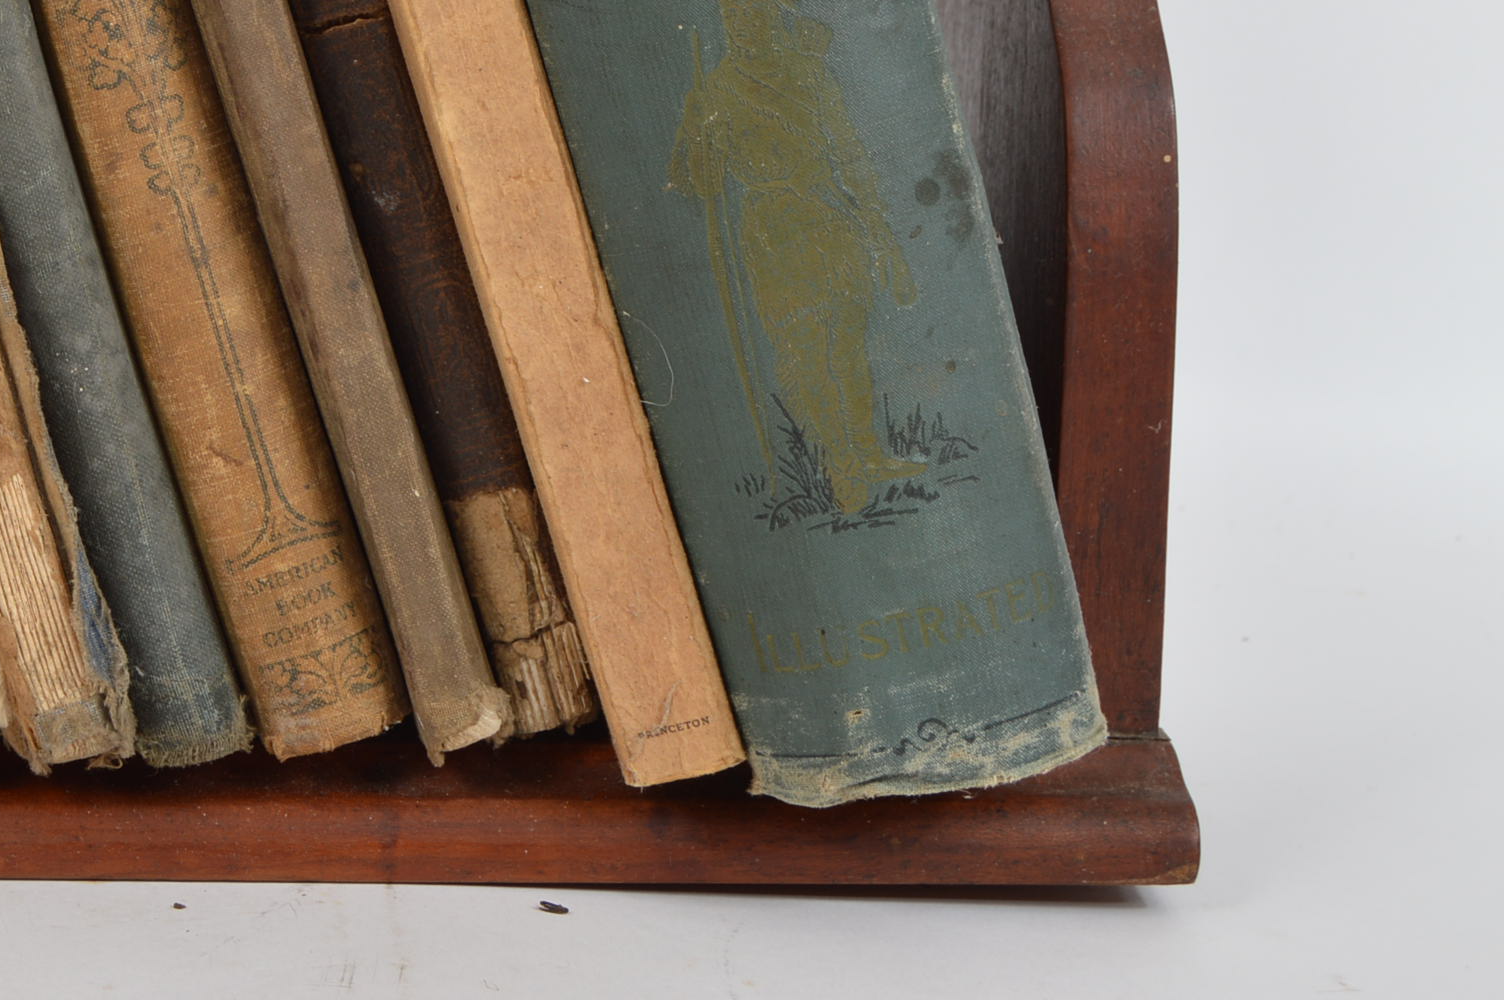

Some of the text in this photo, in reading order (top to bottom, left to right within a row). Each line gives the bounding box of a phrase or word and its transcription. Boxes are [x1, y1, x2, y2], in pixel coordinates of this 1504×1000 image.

[245, 546, 345, 596] AMERICAN
[275, 583, 337, 617] BOOK
[263, 606, 356, 649] COMPANY
[746, 573, 1057, 672] ILLUSTRATED
[638, 716, 710, 739] PRINCETON
